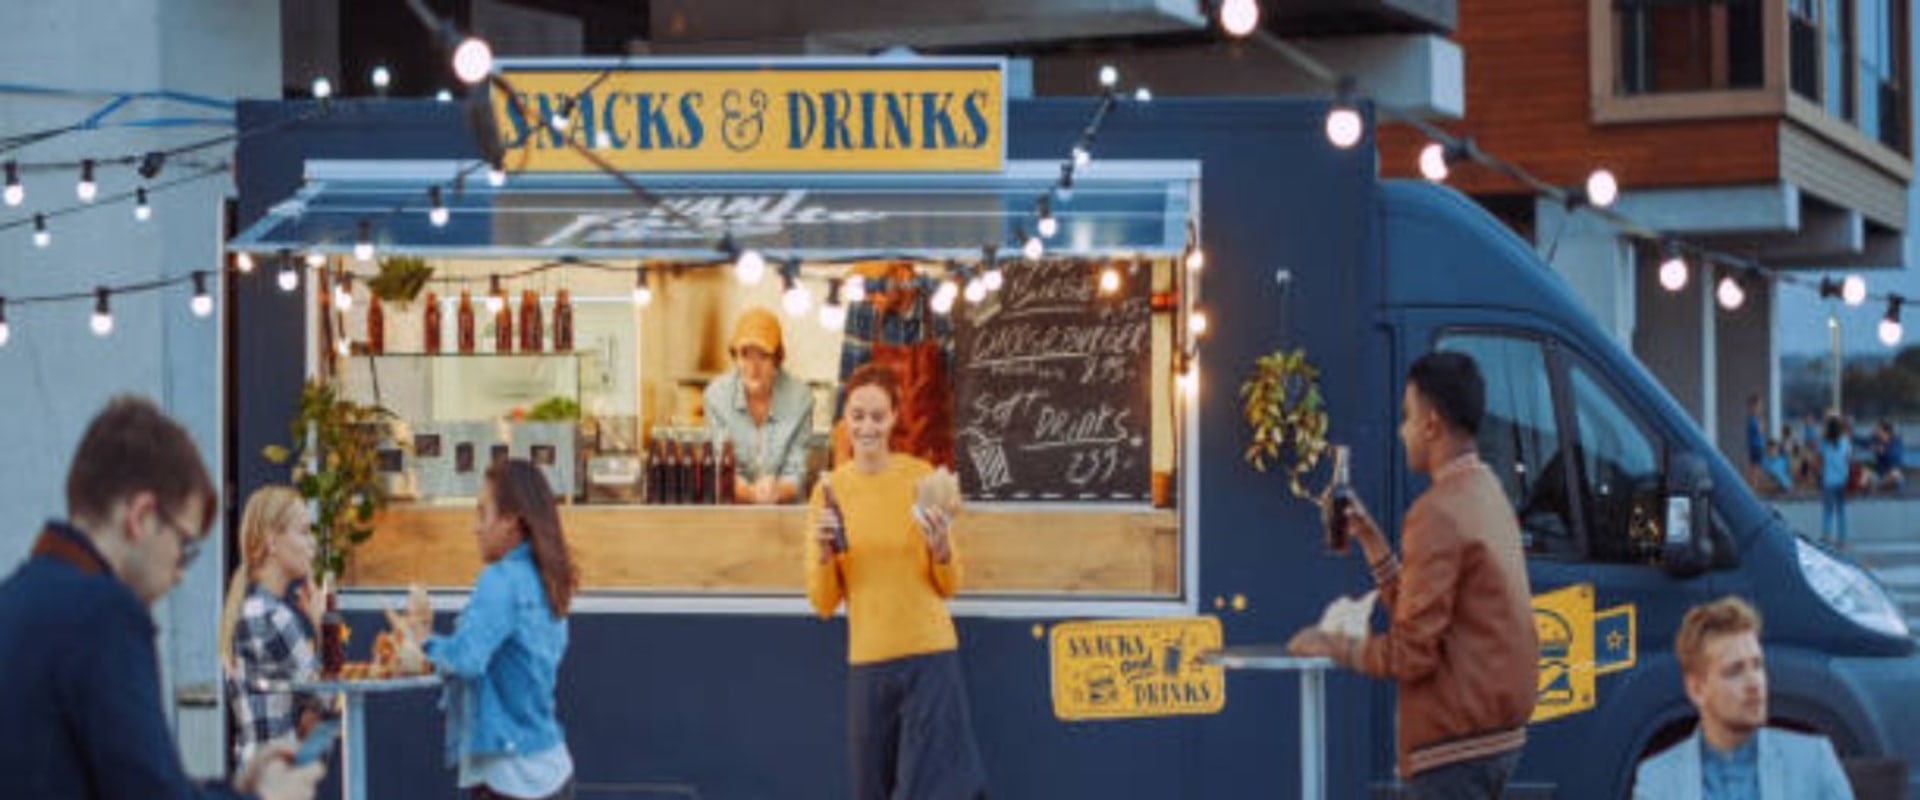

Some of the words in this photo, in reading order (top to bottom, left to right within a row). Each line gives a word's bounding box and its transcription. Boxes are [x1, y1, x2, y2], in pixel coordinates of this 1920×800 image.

[503, 89, 705, 150] SNACKS
[720, 87, 767, 152] &
[786, 90, 990, 150] DRINKS
[1068, 634, 1145, 657] SNACKS
[1119, 649, 1153, 675] and
[1134, 682, 1210, 707] DRINKS
